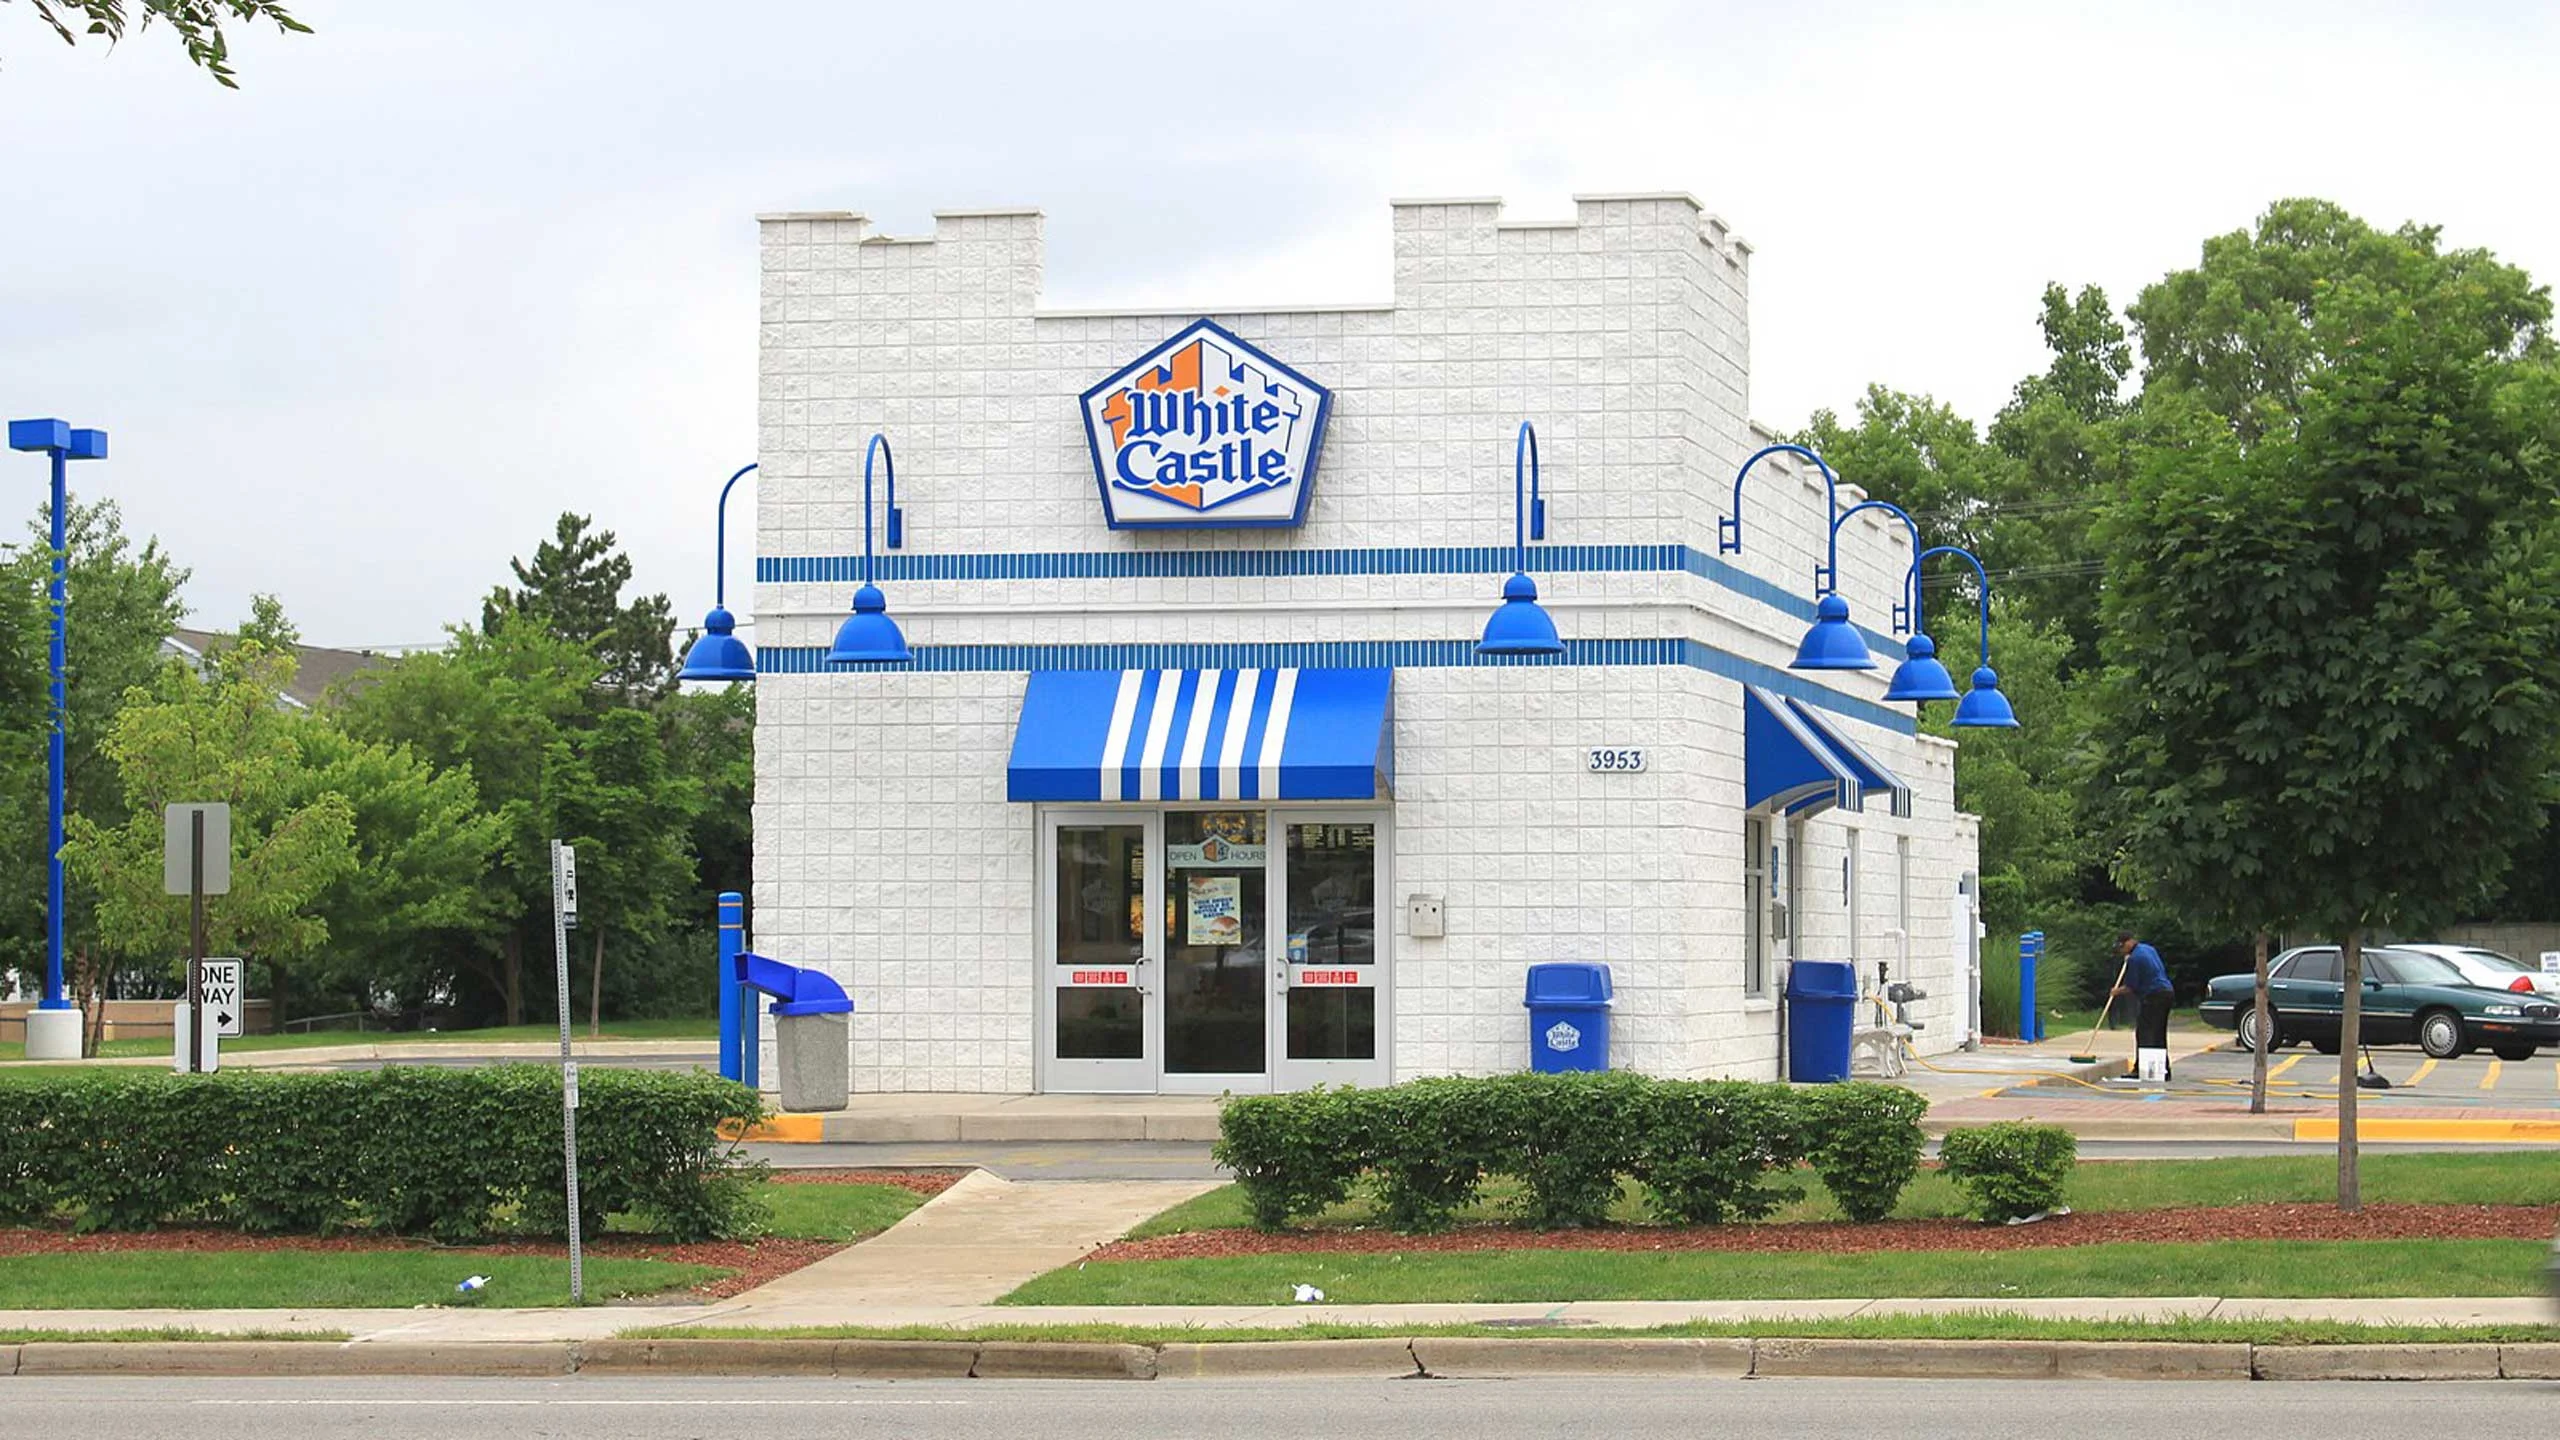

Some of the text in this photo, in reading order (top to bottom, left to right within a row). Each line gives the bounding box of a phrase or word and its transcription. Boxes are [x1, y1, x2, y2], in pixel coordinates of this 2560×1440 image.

[1126, 386, 1280, 445] White
[1116, 438, 1286, 485] Castle
[1591, 750, 1641, 769] 3953
[1169, 851, 1197, 861] OPEN
[1231, 851, 1266, 861] HOURS
[201, 966, 234, 984] ONE
[201, 987, 235, 1005] WAY
